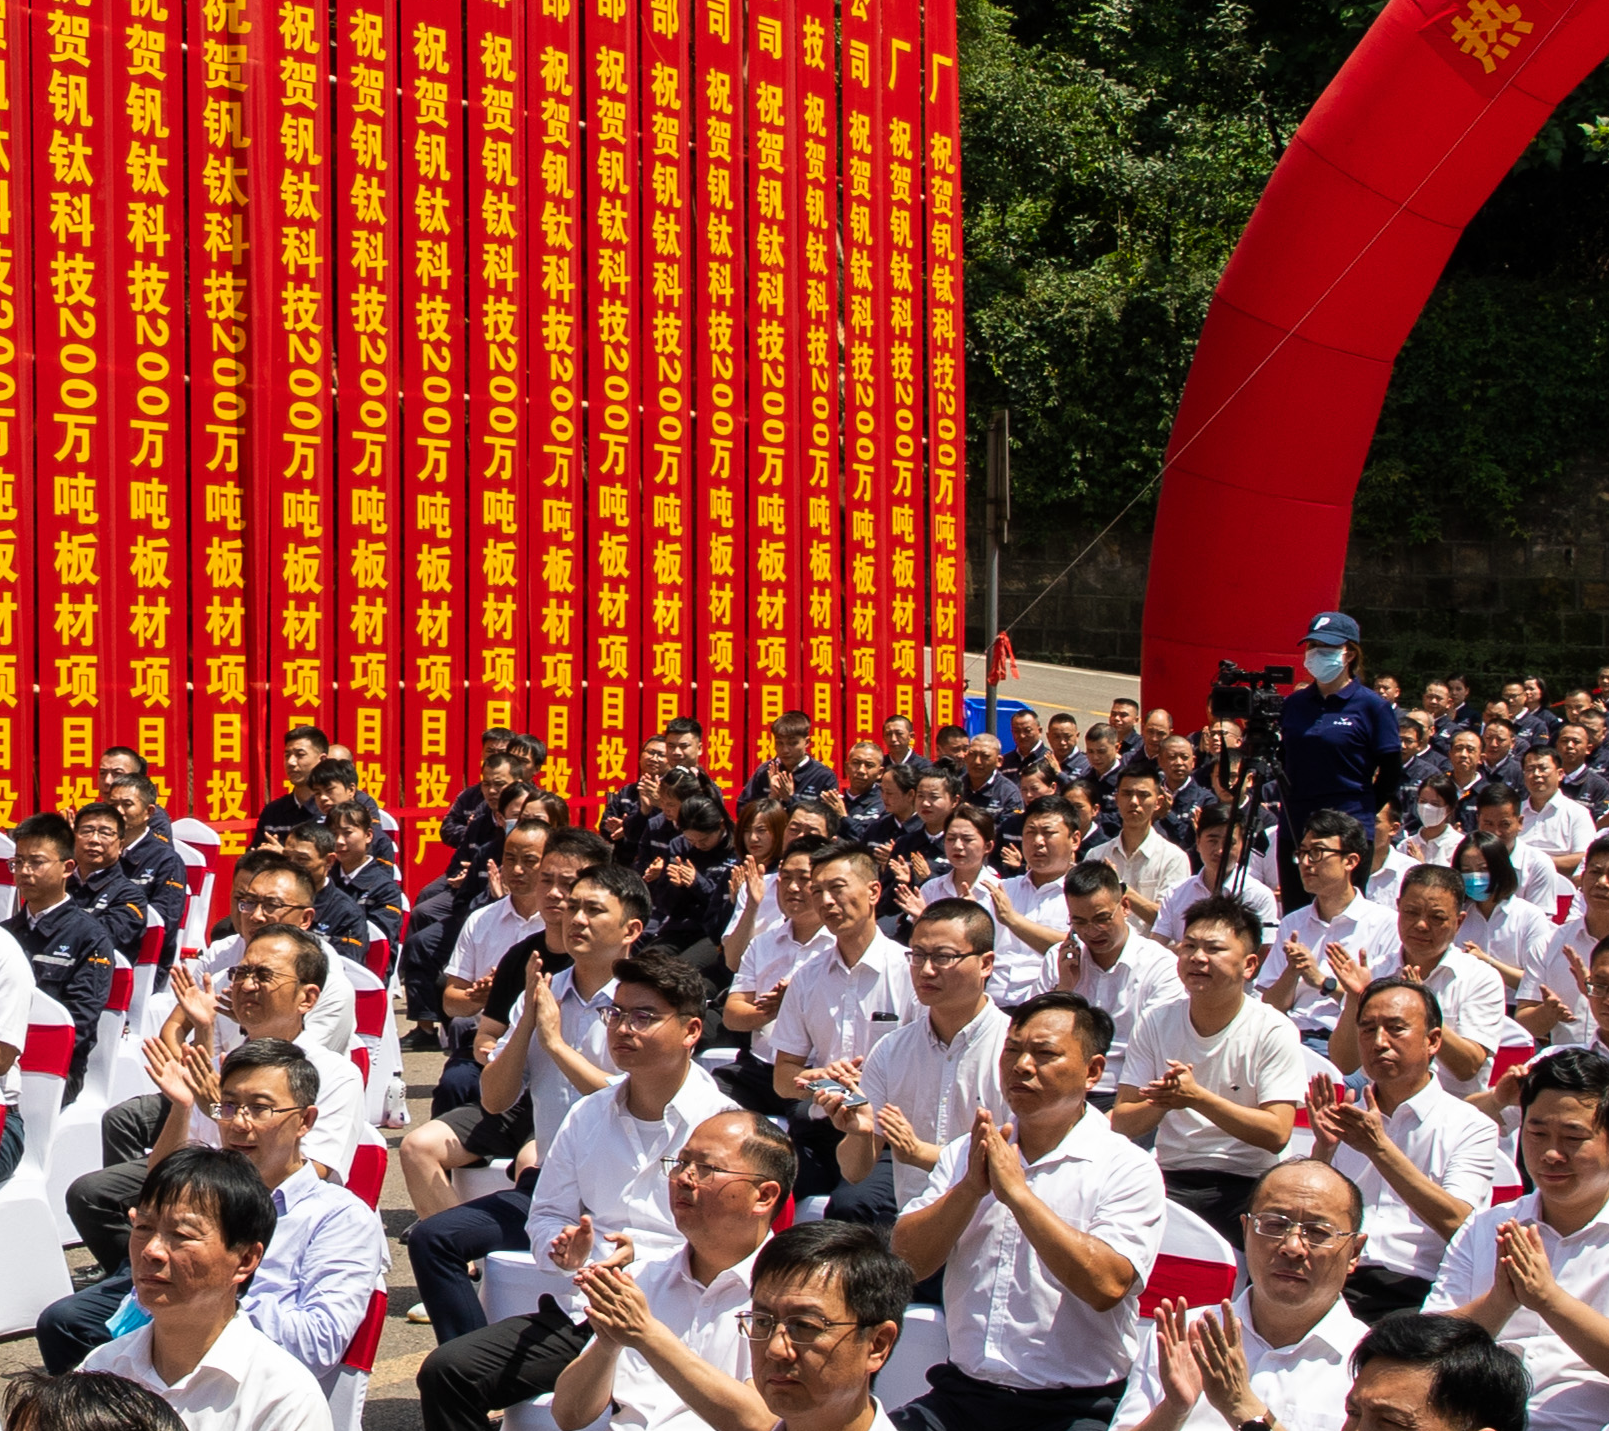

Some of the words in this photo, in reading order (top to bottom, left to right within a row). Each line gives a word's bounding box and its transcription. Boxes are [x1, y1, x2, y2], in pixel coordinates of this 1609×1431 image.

[849, 111, 875, 744] 祝贺钒钛科技200万吨板材项目
[890, 118, 915, 747] 祝贺钒钛科技200万吨板材项目
